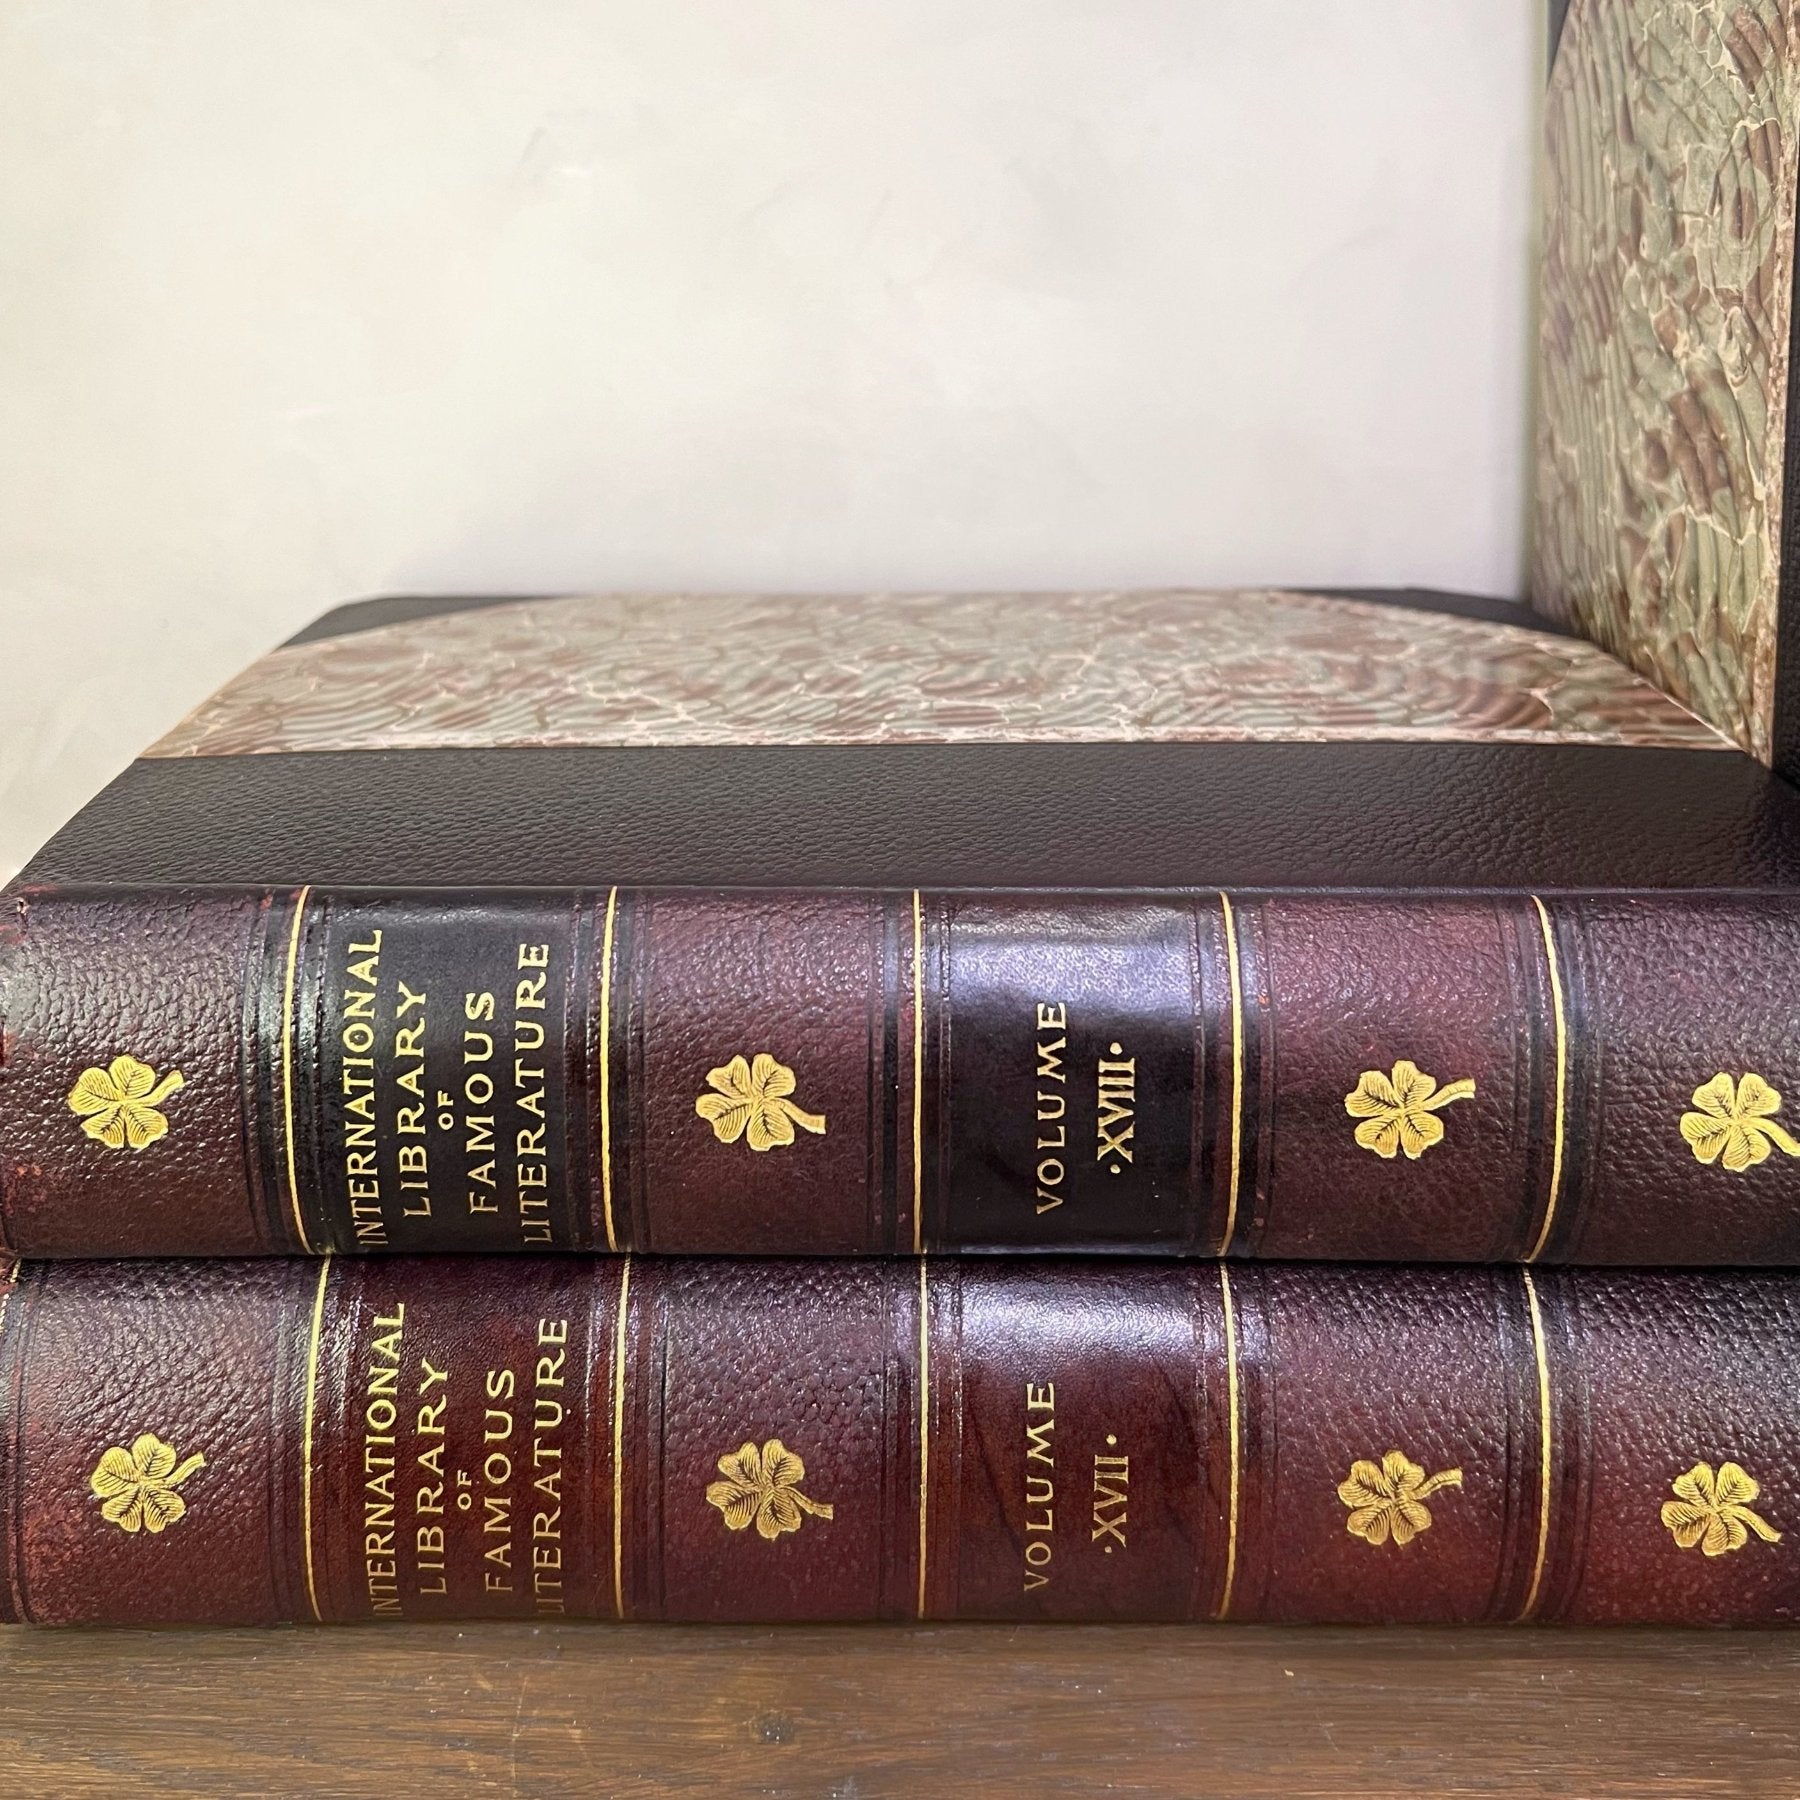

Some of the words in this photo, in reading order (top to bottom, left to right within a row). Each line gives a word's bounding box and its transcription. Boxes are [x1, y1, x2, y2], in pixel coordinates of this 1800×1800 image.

[343, 929, 388, 1244] INTERNATIONAL
[395, 981, 432, 1217] LIBRARY
[437, 1090, 454, 1130] OF
[464, 991, 498, 1214] FAMOUS
[515, 943, 552, 1243] LITERATURE
[1037, 1002, 1066, 1215] VOLUME
[365, 1302, 405, 1616] INTERNATIONAL
[417, 1357, 448, 1595] LIBRARY
[457, 1469, 472, 1511] OF
[484, 1369, 515, 1592] FAMOUS
[533, 1318, 568, 1614] LITERATURE
[1024, 1382, 1055, 1592] VOLUME
